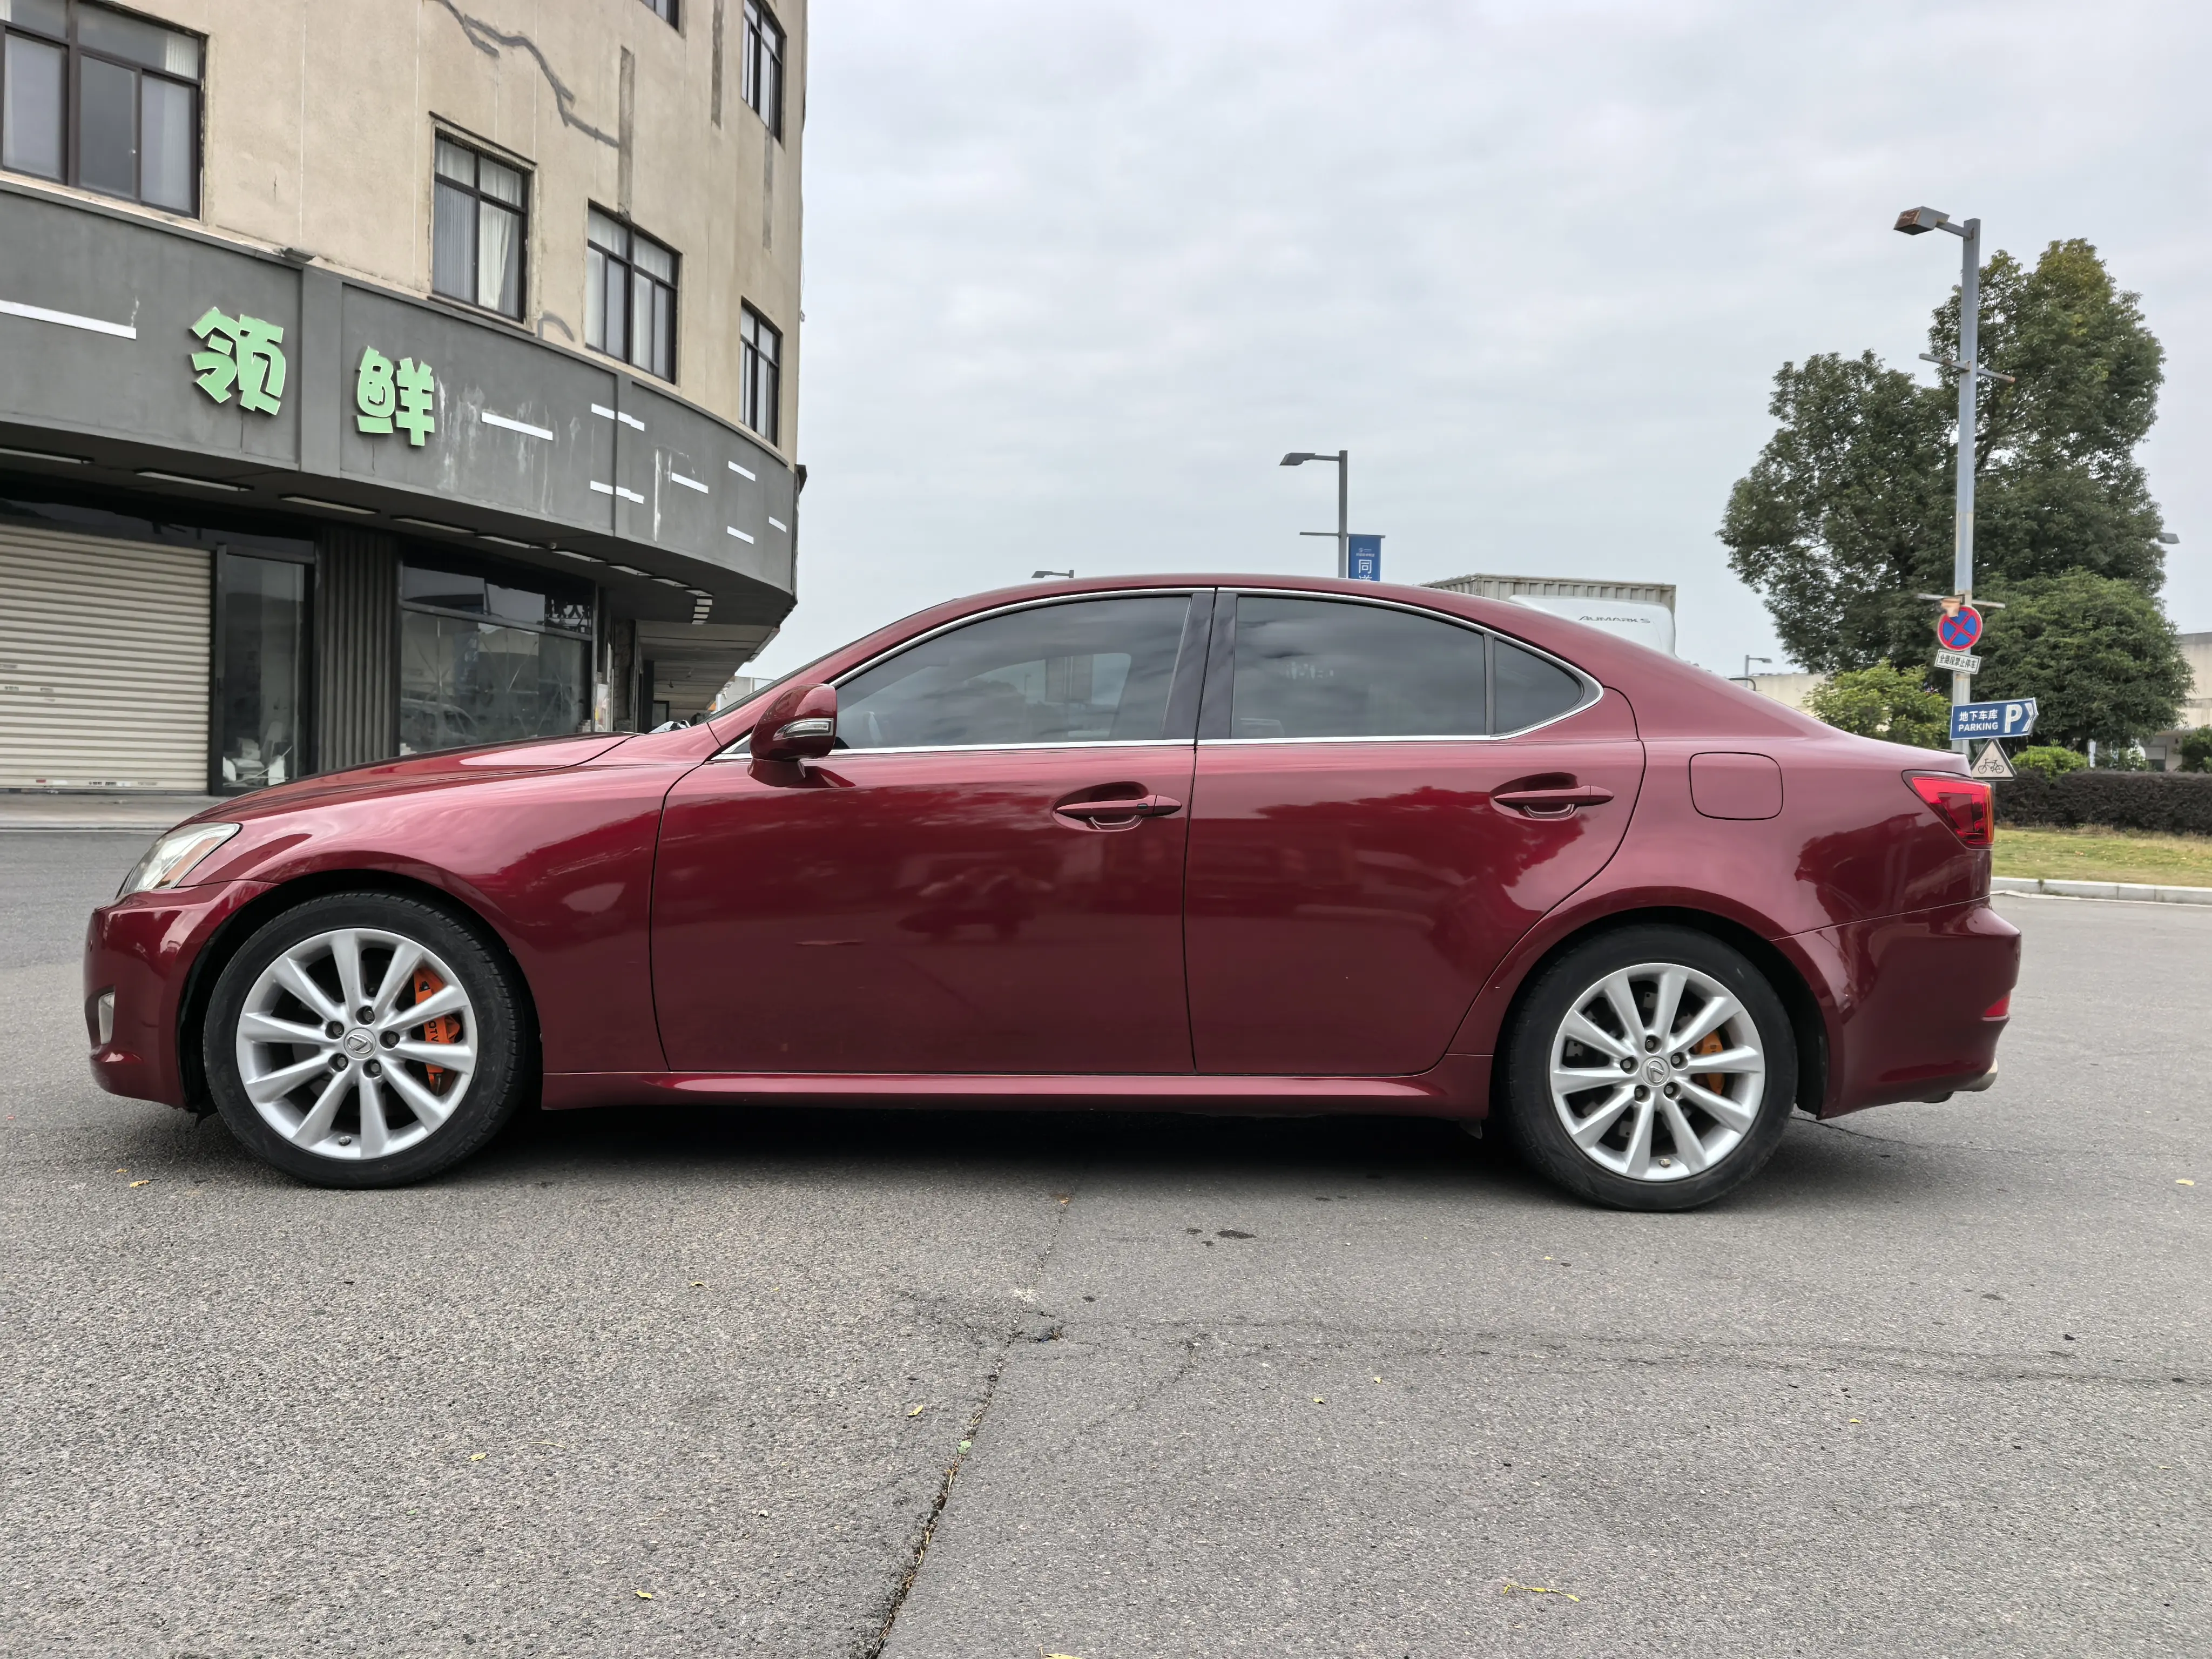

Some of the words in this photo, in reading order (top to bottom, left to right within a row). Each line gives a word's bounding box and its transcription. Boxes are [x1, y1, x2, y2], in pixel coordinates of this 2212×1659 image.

[1959, 709, 1998, 721] 地下车库
[2005, 704, 2022, 733] P
[1958, 721, 1999, 732] PARKING
